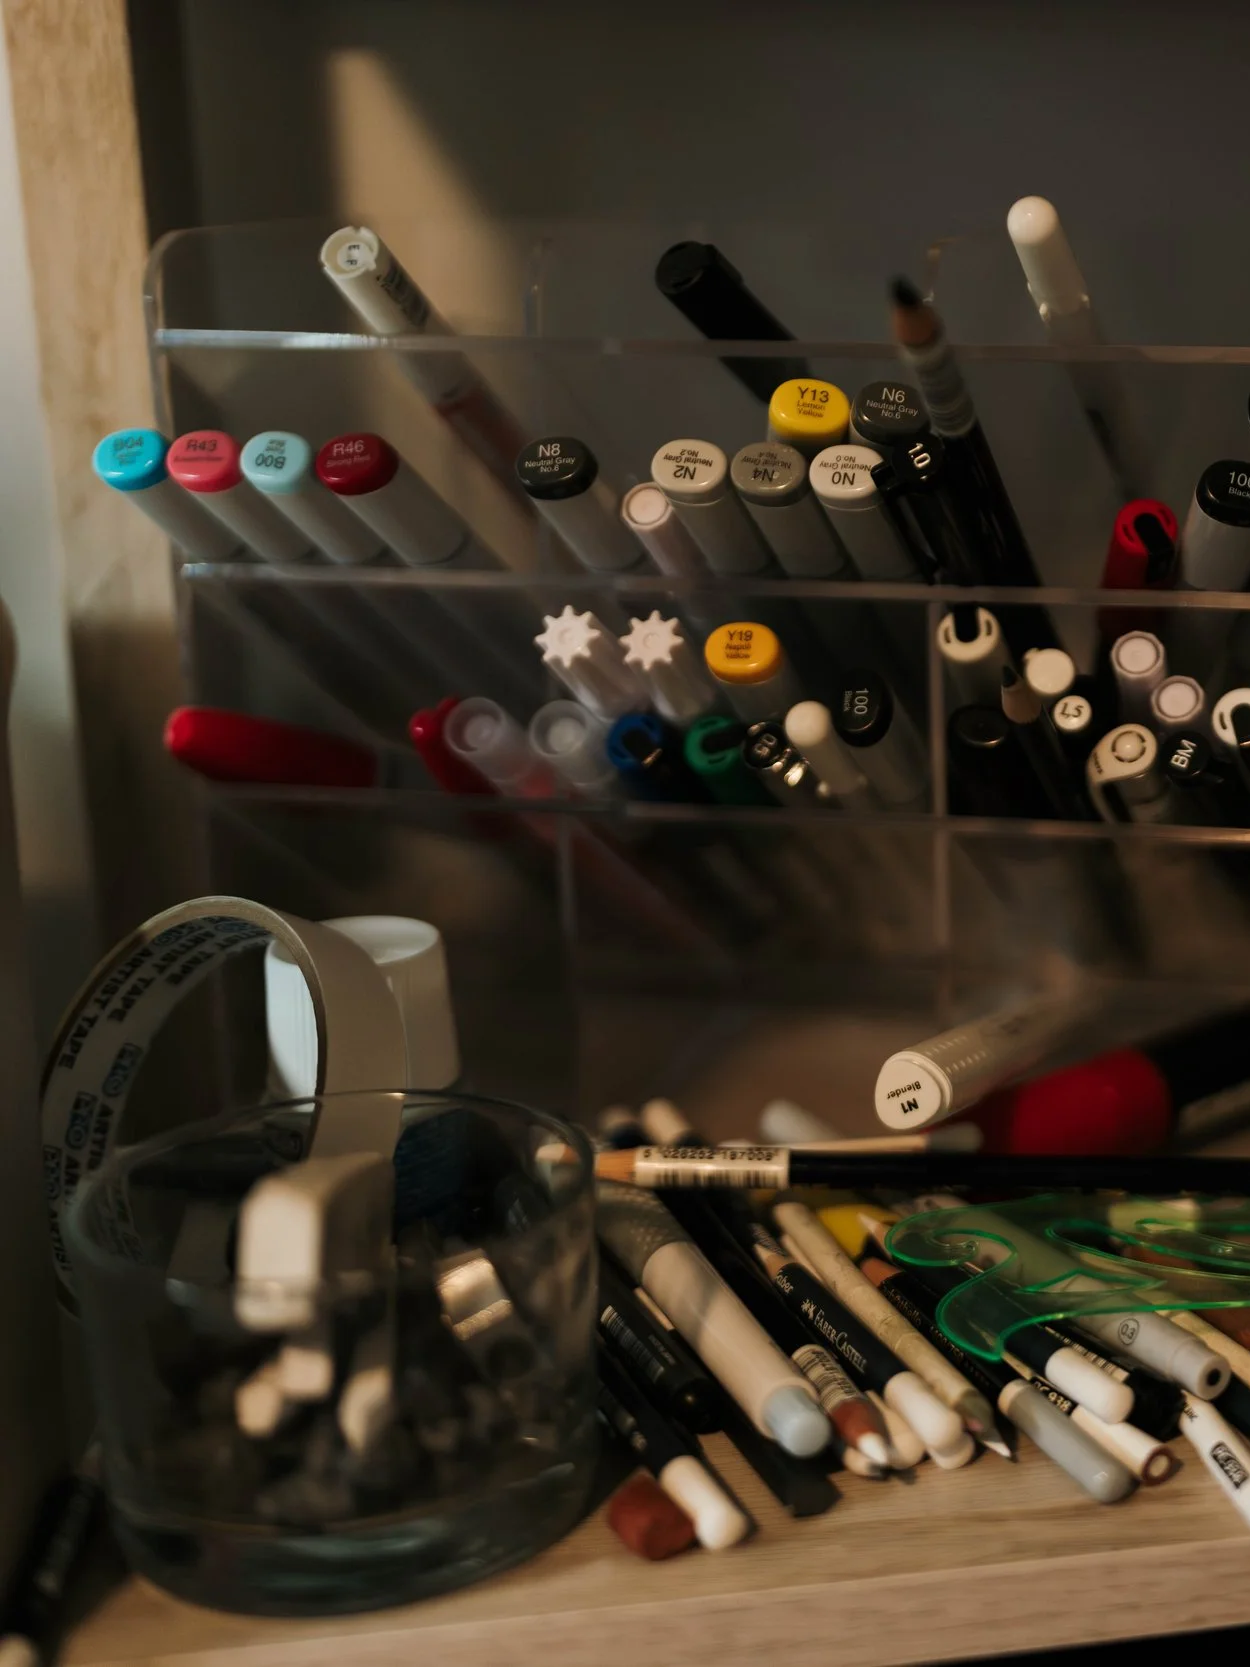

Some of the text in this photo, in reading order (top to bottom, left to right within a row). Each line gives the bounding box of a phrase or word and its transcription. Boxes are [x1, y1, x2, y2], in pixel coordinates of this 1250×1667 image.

[797, 386, 829, 403] Y13
[881, 387, 905, 403] N6
[332, 440, 365, 457] R46
[538, 443, 561, 458] N8
[525, 456, 576, 468] Neutral Gray
[663, 453, 714, 467] Neutral Gray
[819, 460, 839, 470] Gray
[673, 465, 697, 480] N2
[751, 468, 775, 482] N4
[832, 471, 855, 485] N0
[854, 687, 869, 715] 100
[106, 976, 155, 1023] TAPE
[58, 1011, 99, 1070] TAPE
[887, 1081, 921, 1100] Blender
[900, 1097, 919, 1114] N1
